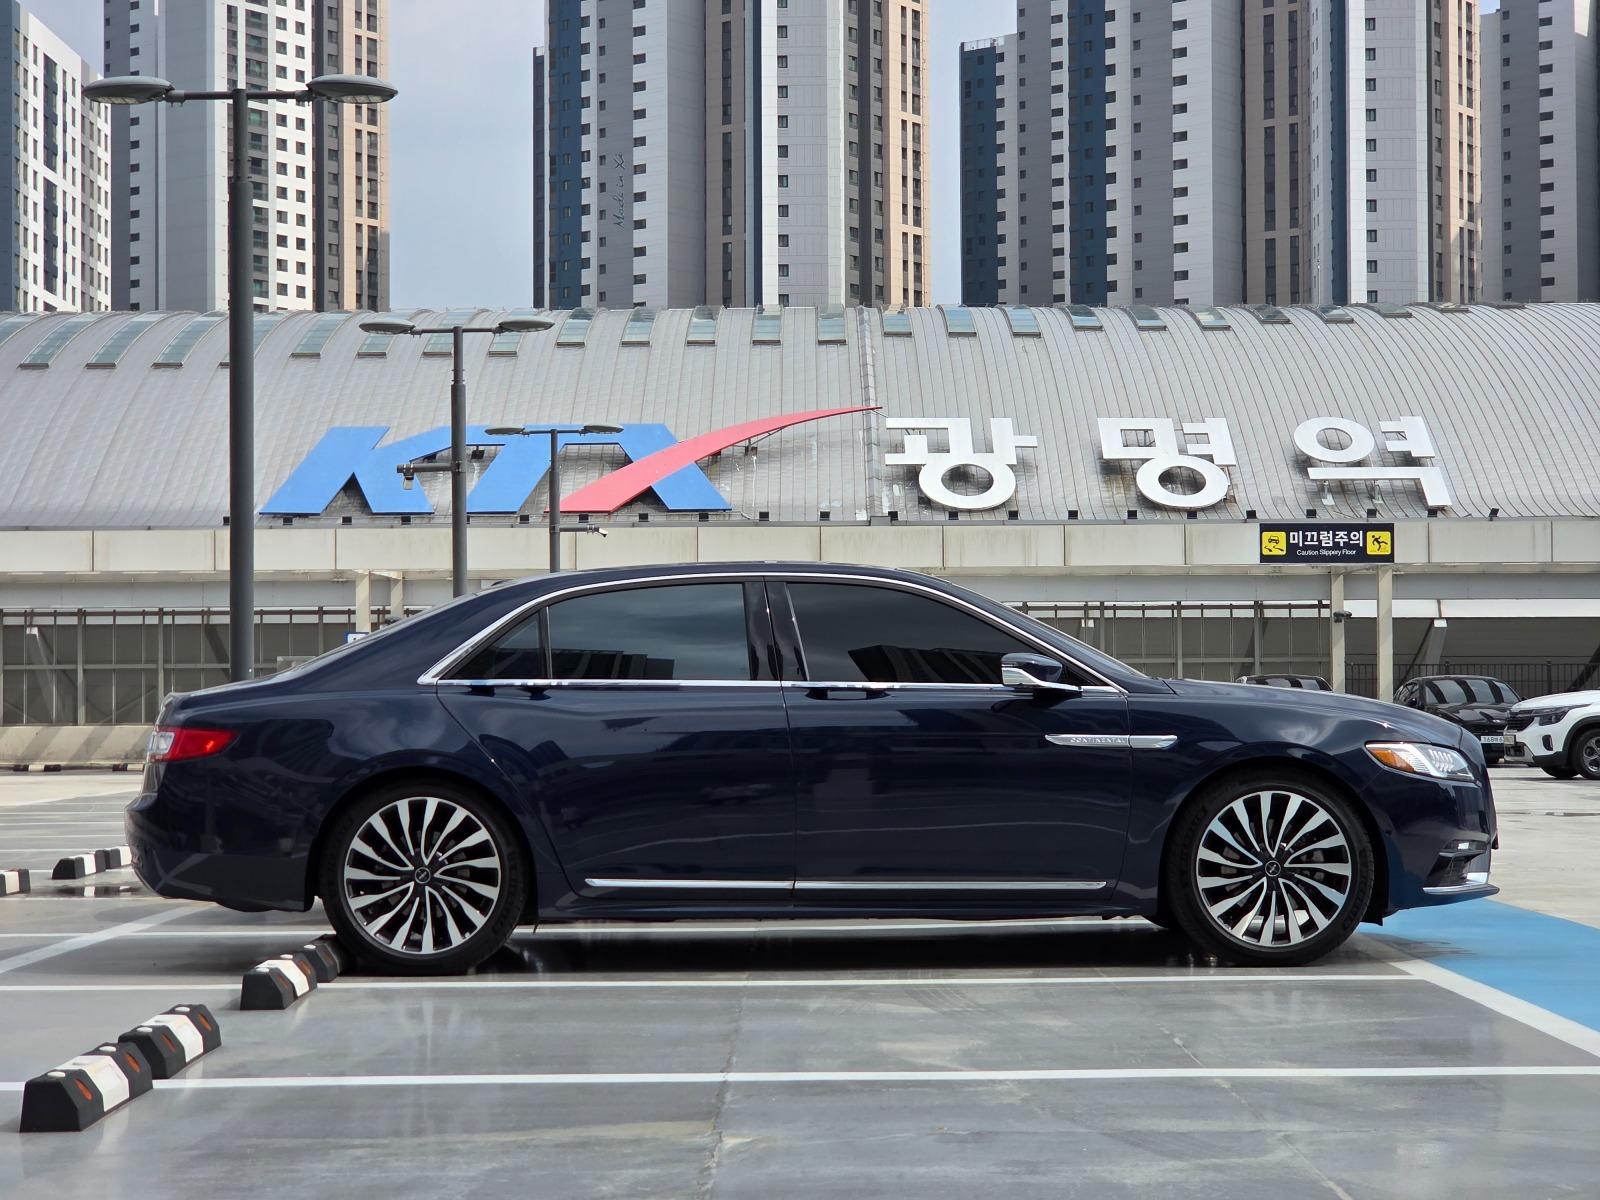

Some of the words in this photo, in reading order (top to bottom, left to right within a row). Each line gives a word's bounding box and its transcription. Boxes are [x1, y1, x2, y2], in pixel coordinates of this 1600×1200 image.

[613, 153, 626, 170] Xi
[616, 176, 624, 188] in
[612, 192, 625, 230] Made
[259, 406, 882, 515] KTX
[885, 415, 1452, 510] 광명역
[1289, 530, 1363, 547] 미끄럼주의
[1319, 548, 1341, 557] Slippery
[1342, 548, 1356, 556] Floor
